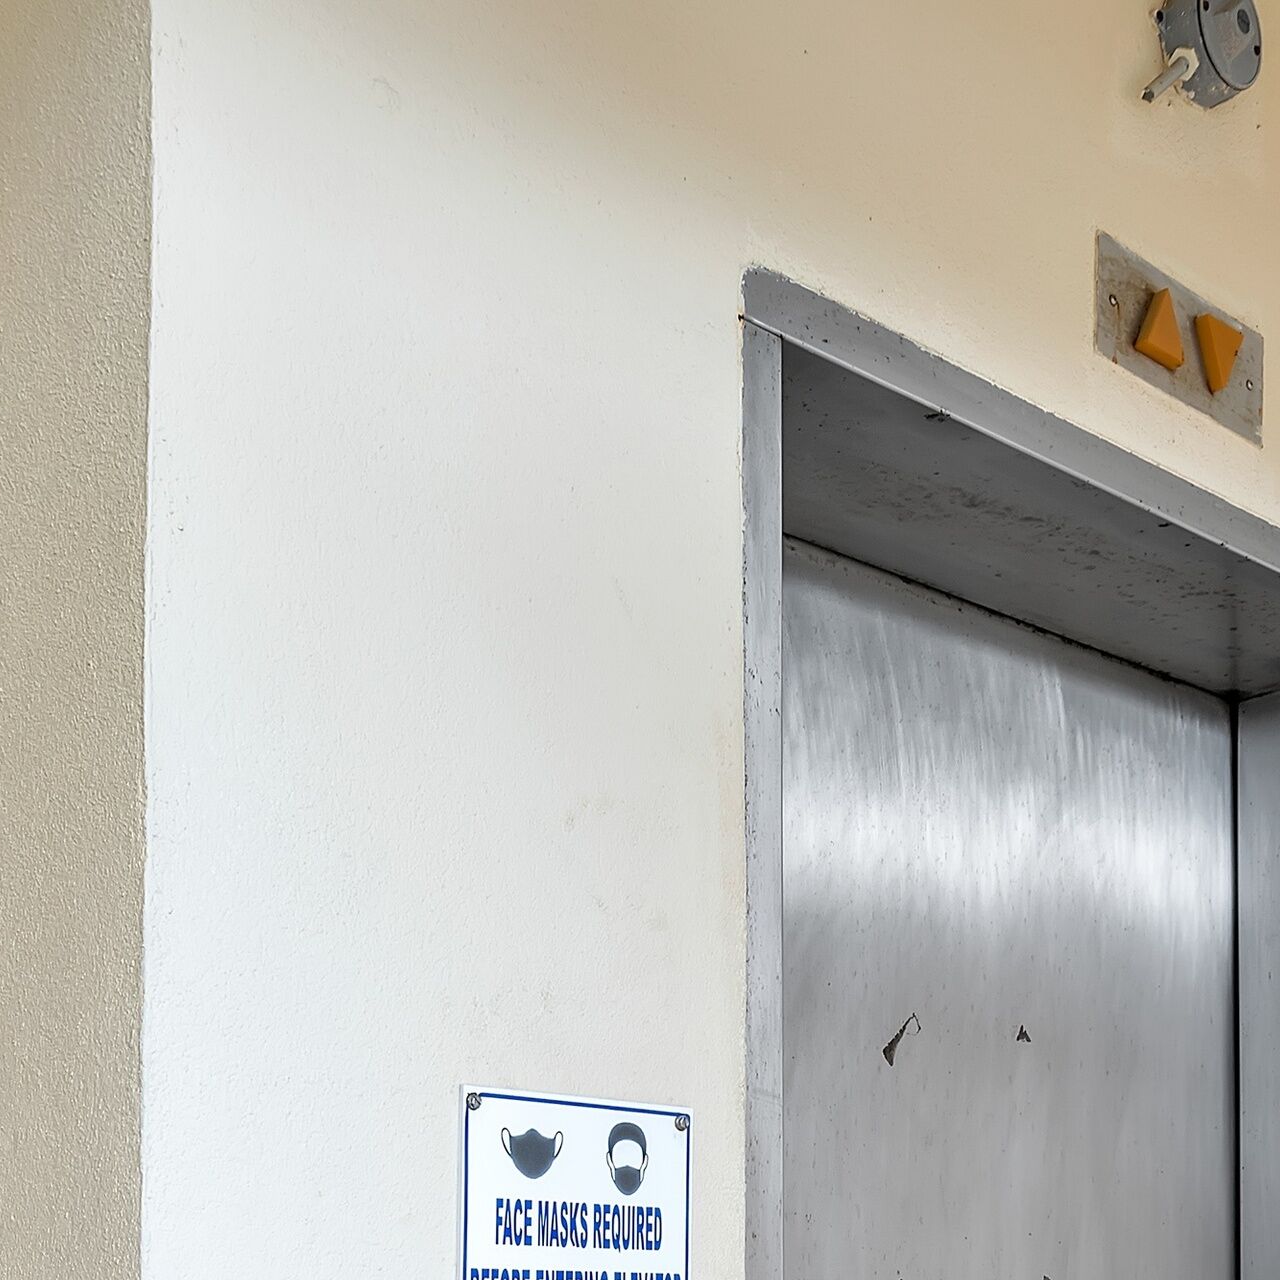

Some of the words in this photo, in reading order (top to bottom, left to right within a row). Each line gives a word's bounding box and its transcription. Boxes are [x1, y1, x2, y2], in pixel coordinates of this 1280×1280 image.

[495, 1198, 533, 1246] FACE
[537, 1200, 588, 1248] MASKS
[593, 1203, 662, 1253] REQUIRED
